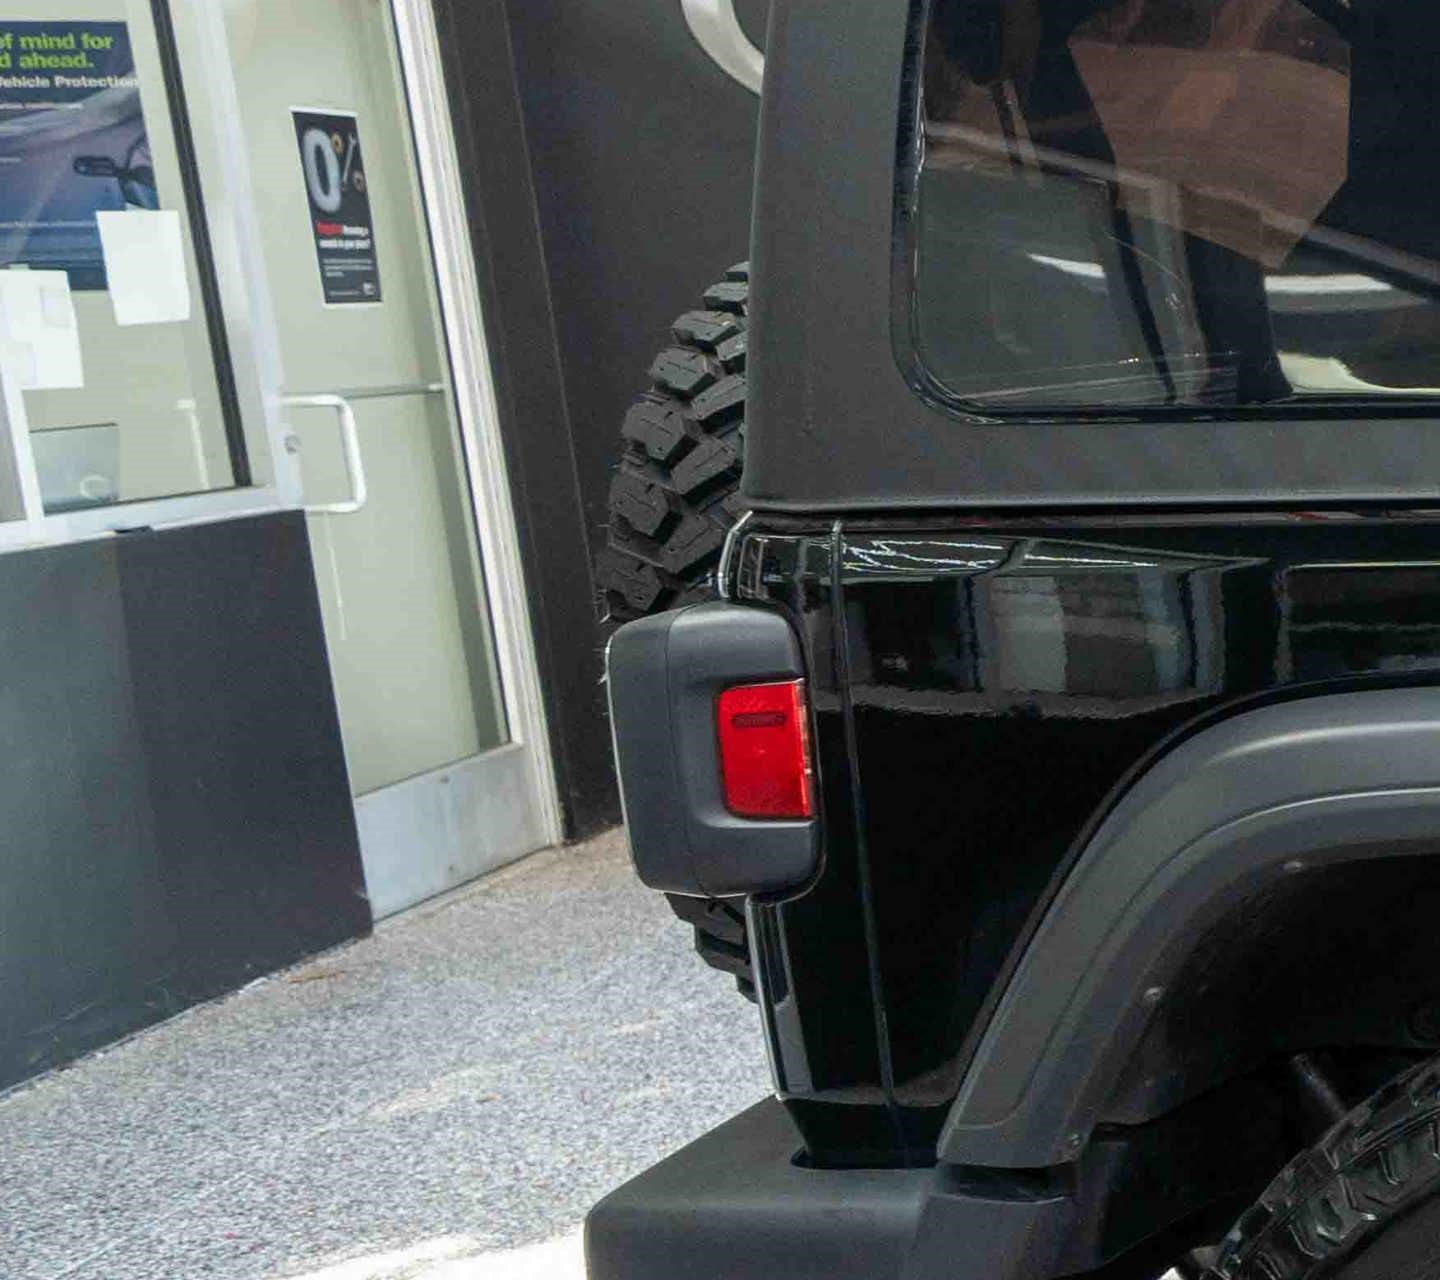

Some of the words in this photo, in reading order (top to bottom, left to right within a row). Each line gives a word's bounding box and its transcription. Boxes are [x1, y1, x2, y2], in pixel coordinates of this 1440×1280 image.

[20, 32, 76, 49] mind
[81, 32, 114, 49] for
[20, 52, 95, 68] ahead.
[54, 76, 139, 89] Protection
